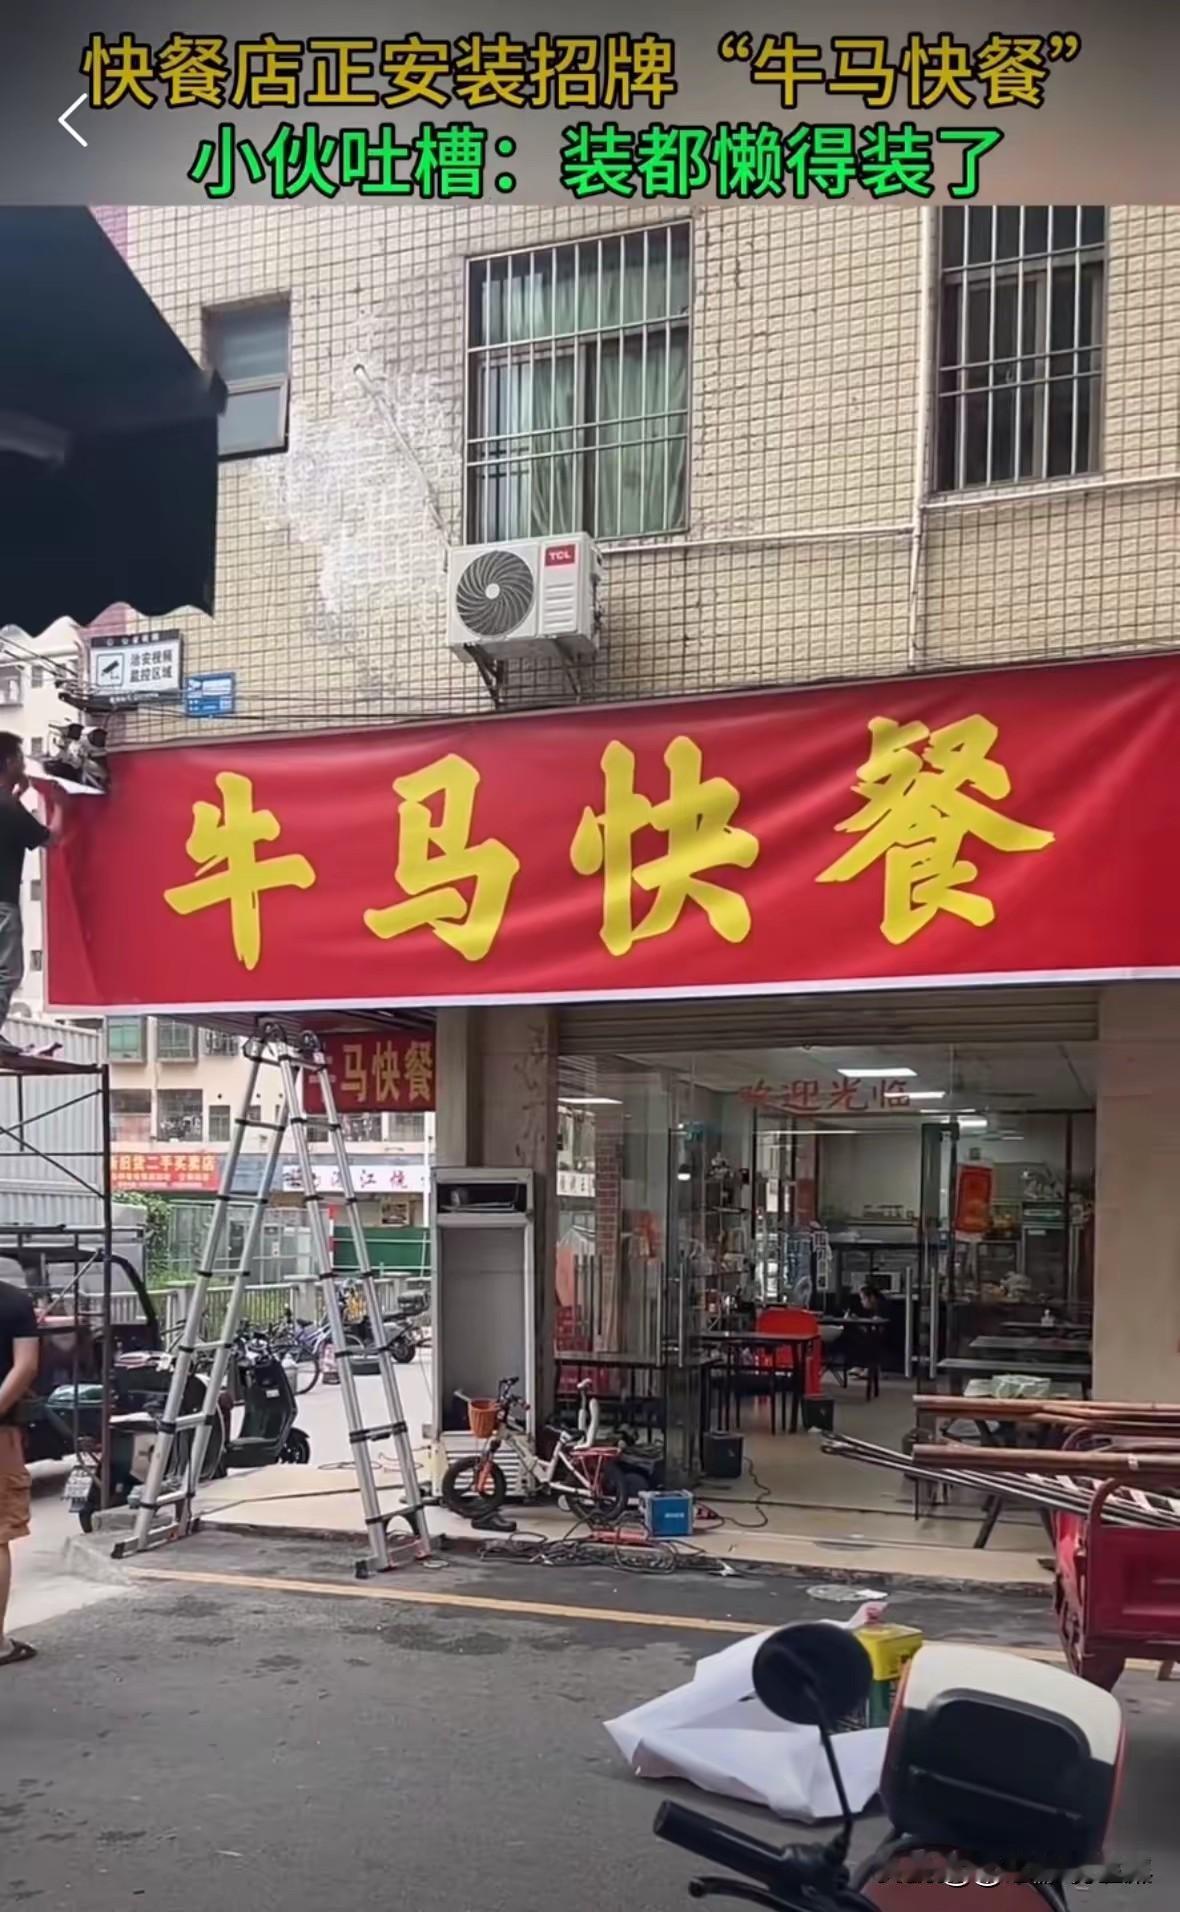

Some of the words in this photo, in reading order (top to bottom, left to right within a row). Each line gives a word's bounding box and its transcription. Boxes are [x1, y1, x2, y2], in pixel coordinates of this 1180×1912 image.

[549, 551, 572, 561] TCL
[130, 666, 173, 683] 监控区域
[163, 714, 1055, 971] 牛马快餐
[739, 1078, 911, 1111] 欢迎光临
